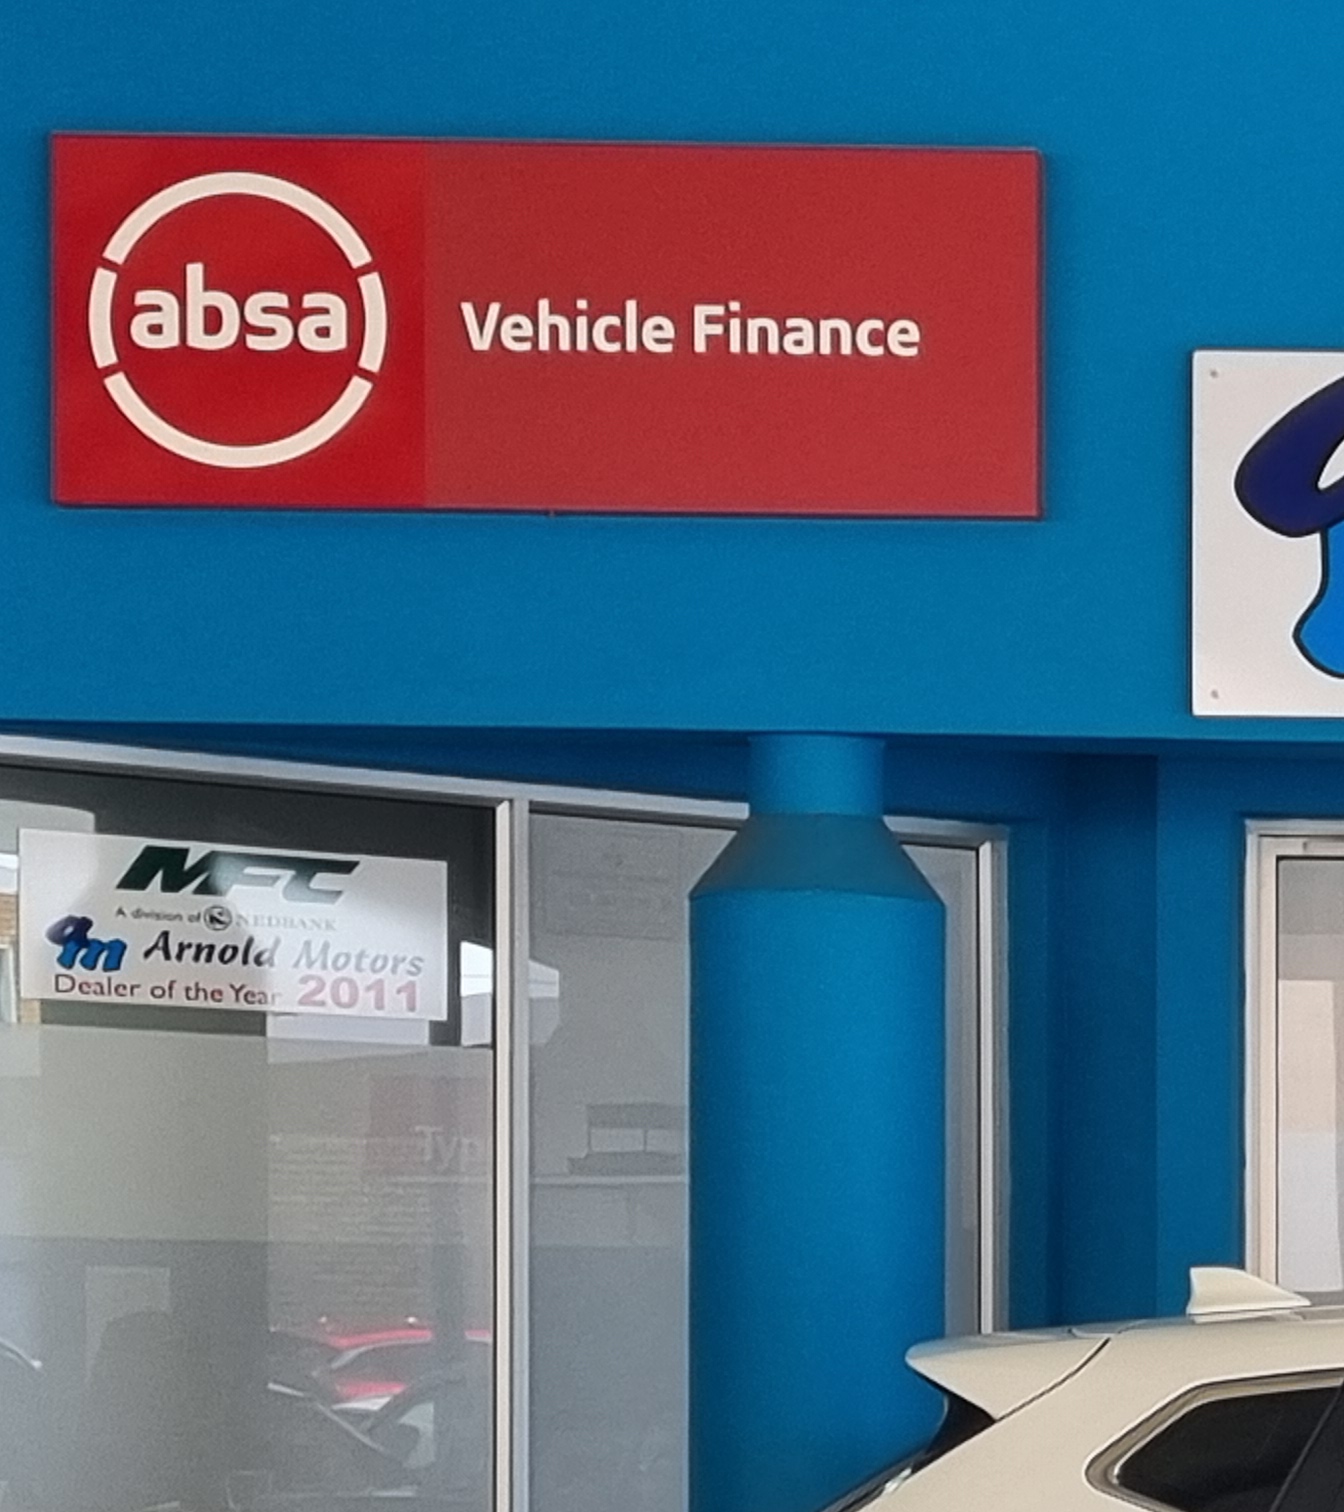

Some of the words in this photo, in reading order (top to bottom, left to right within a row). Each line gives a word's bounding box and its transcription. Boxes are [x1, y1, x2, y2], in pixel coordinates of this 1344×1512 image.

[129, 263, 348, 353] absa
[461, 298, 676, 354] Vehicle
[694, 301, 921, 358] Finance
[116, 844, 360, 905] MFC
[131, 907, 184, 923] division
[186, 910, 201, 924] of
[235, 912, 337, 932] NEDBANK
[143, 929, 281, 968] Arnold
[292, 939, 425, 977] Motors
[54, 974, 141, 999] Dealer
[150, 978, 177, 1000] of
[184, 981, 223, 1004] the
[228, 983, 282, 1006] Year
[297, 973, 419, 1013] 2011
